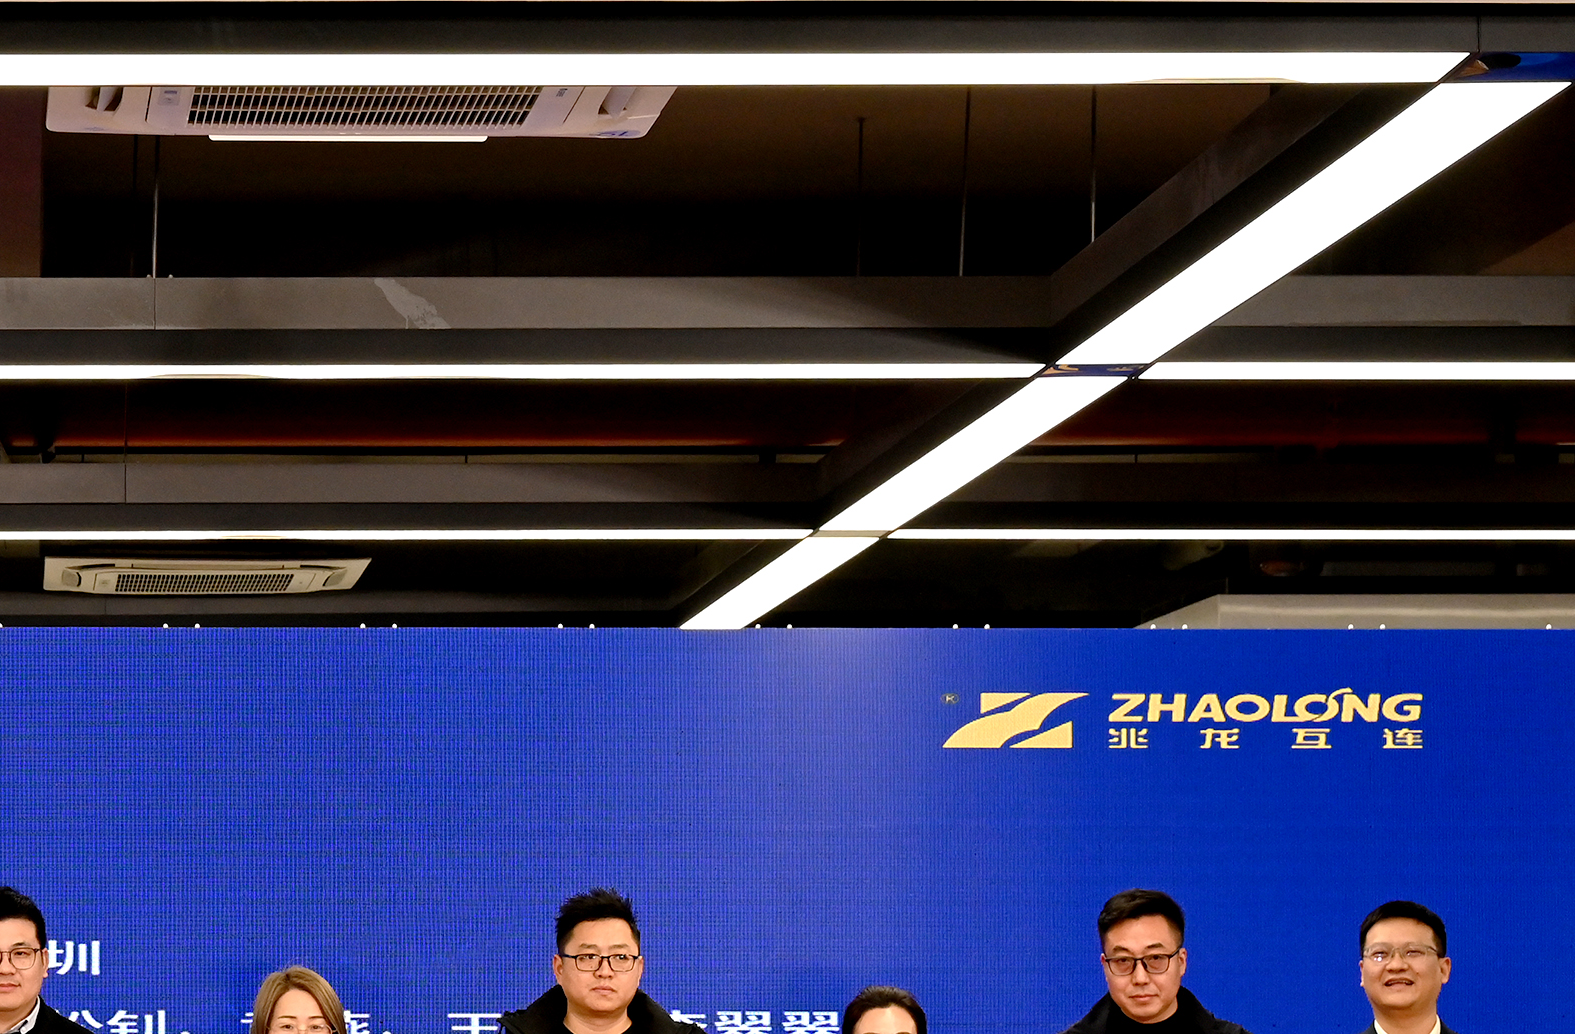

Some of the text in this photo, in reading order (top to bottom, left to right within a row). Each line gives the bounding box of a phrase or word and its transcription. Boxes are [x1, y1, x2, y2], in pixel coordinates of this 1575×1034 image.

[1109, 687, 1423, 722] ZHAOLONG
[1109, 728, 1423, 749] 兆龙互连
